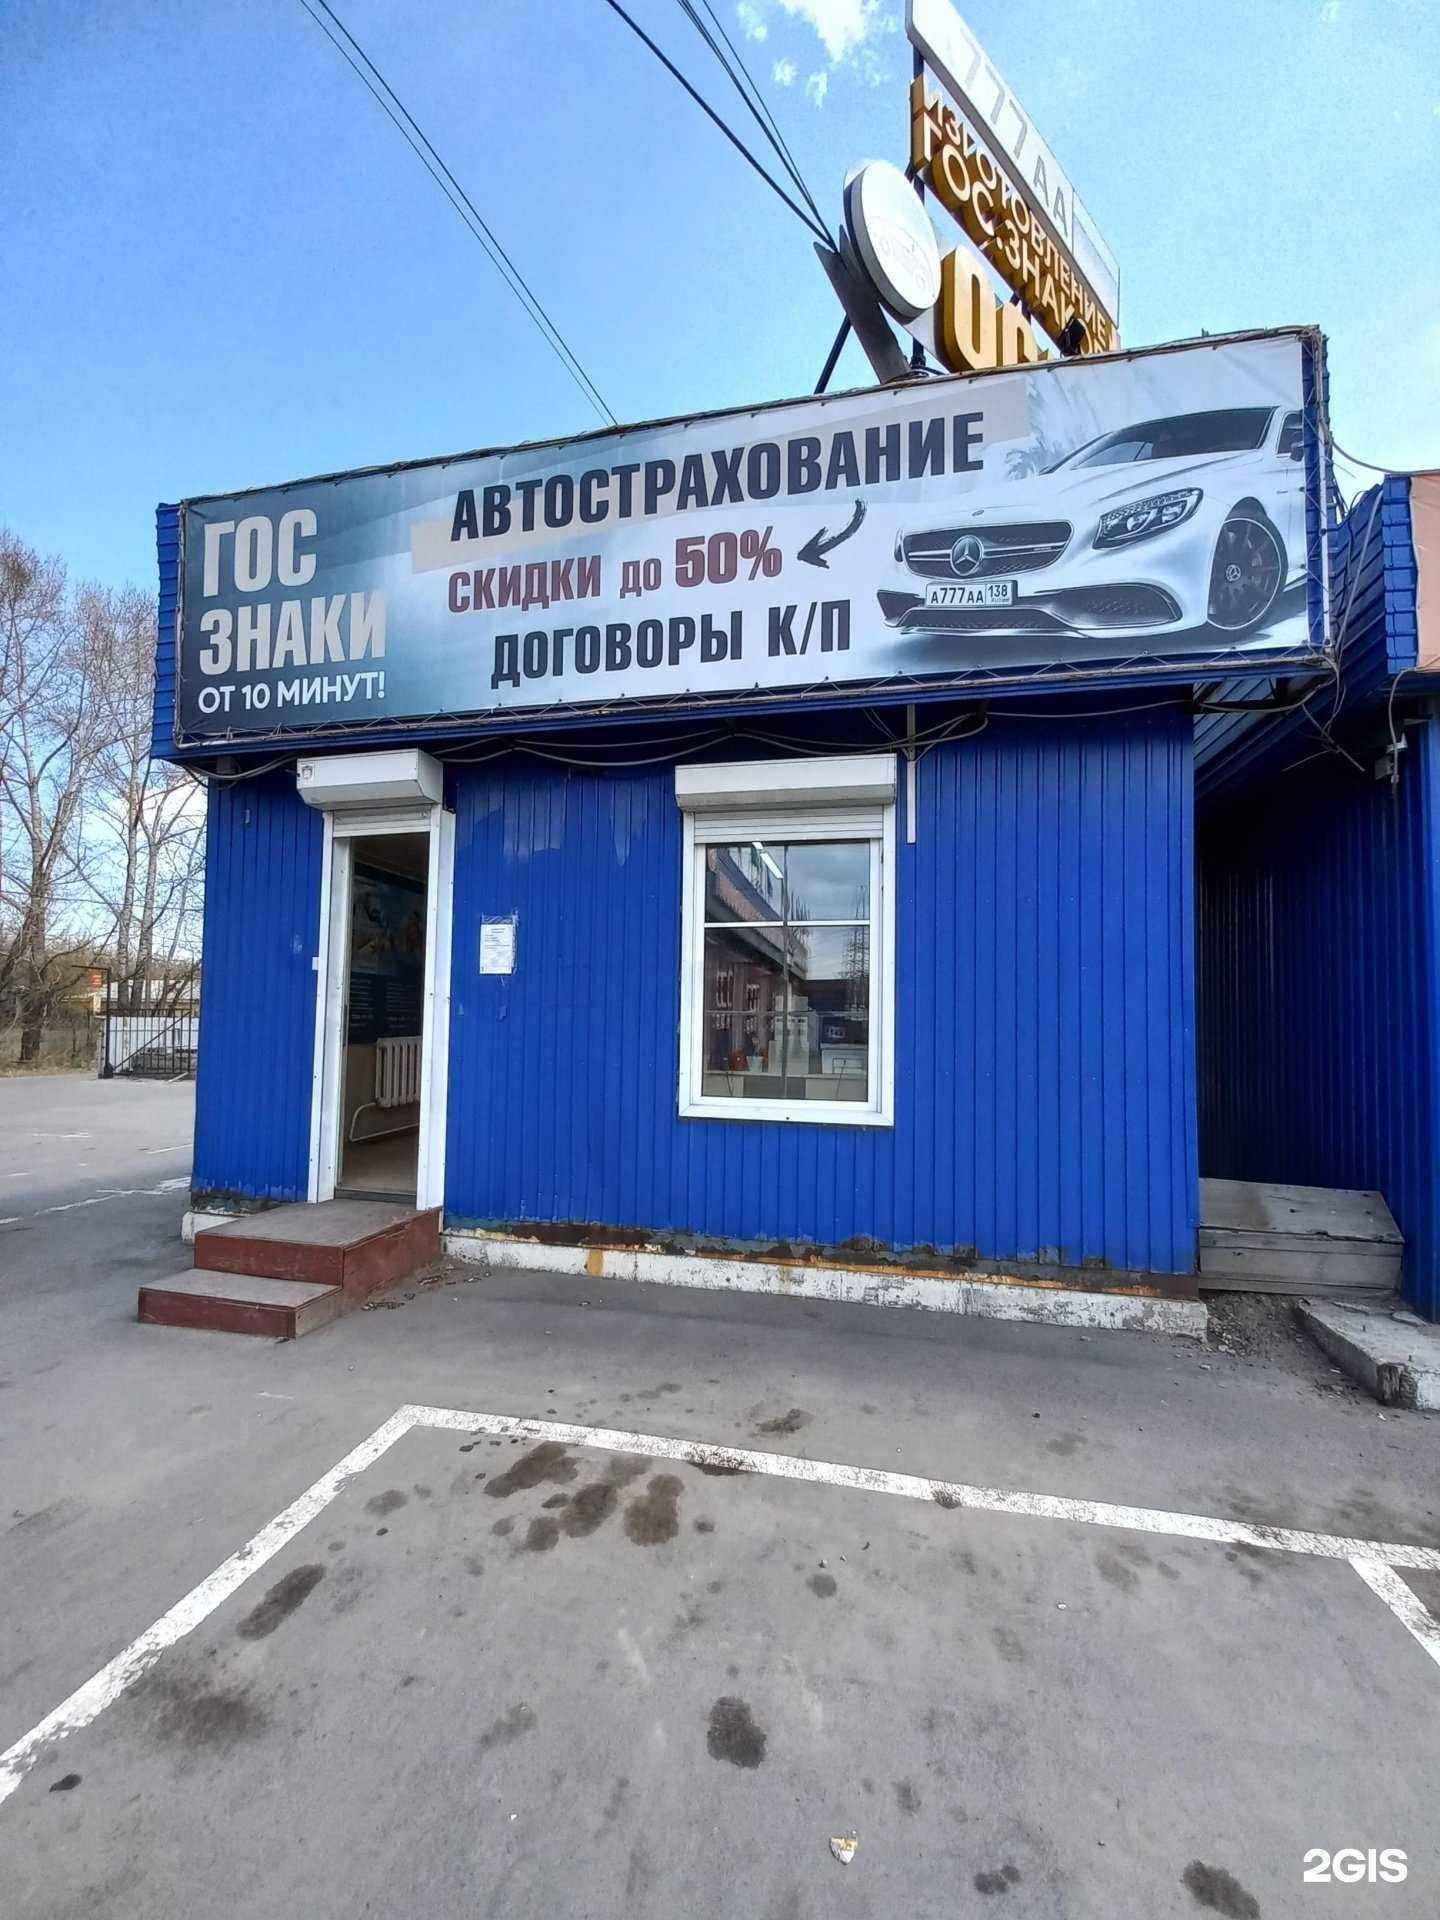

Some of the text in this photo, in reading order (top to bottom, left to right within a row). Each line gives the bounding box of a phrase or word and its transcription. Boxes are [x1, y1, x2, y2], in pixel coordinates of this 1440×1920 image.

[922, 74, 1106, 349] ИЗГОТОВЛЕНИЕ
[450, 412, 984, 541] АВТОСТРАХОВАНИЕ
[203, 509, 318, 597] ГОС
[448, 555, 601, 612] СКИДКИ
[675, 527, 783, 587] 50%
[988, 585, 1008, 598] 138
[199, 589, 387, 676] ЗНАКИ
[491, 599, 851, 689] ДОГОВОРЫ К/П
[198, 672, 385, 714] ОТ 10 МИНУТ!
